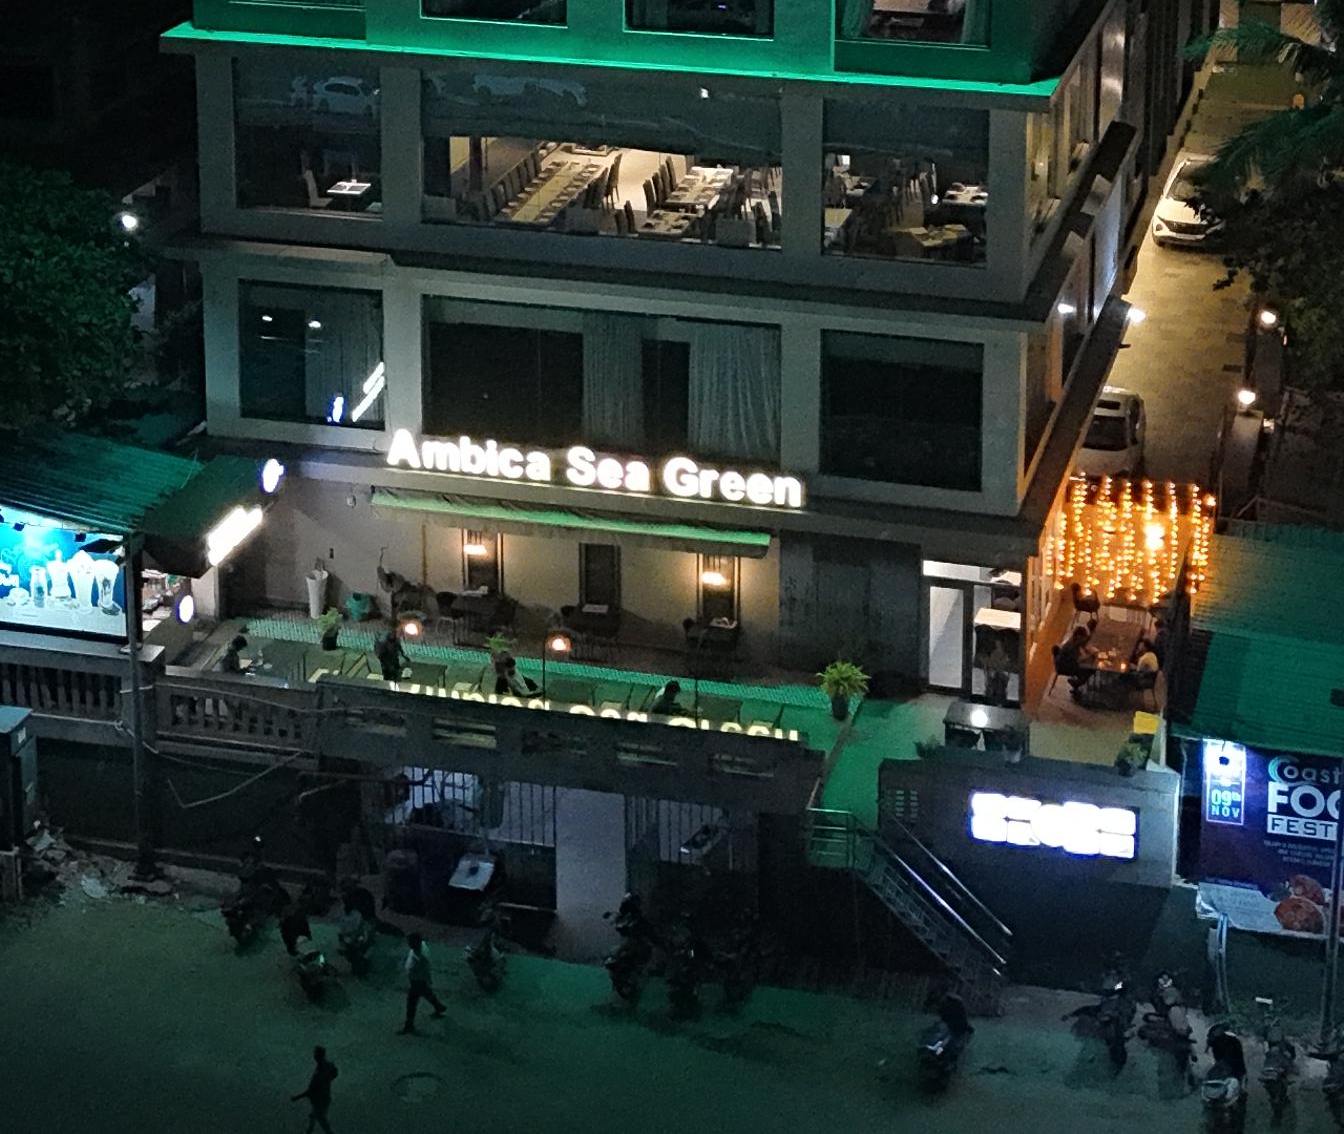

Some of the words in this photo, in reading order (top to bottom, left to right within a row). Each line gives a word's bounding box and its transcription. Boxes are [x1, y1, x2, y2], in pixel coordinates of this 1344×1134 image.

[386, 428, 552, 482] Ambica
[565, 445, 651, 492] Sea
[663, 456, 803, 507] Green
[1211, 805, 1240, 818] NOV
